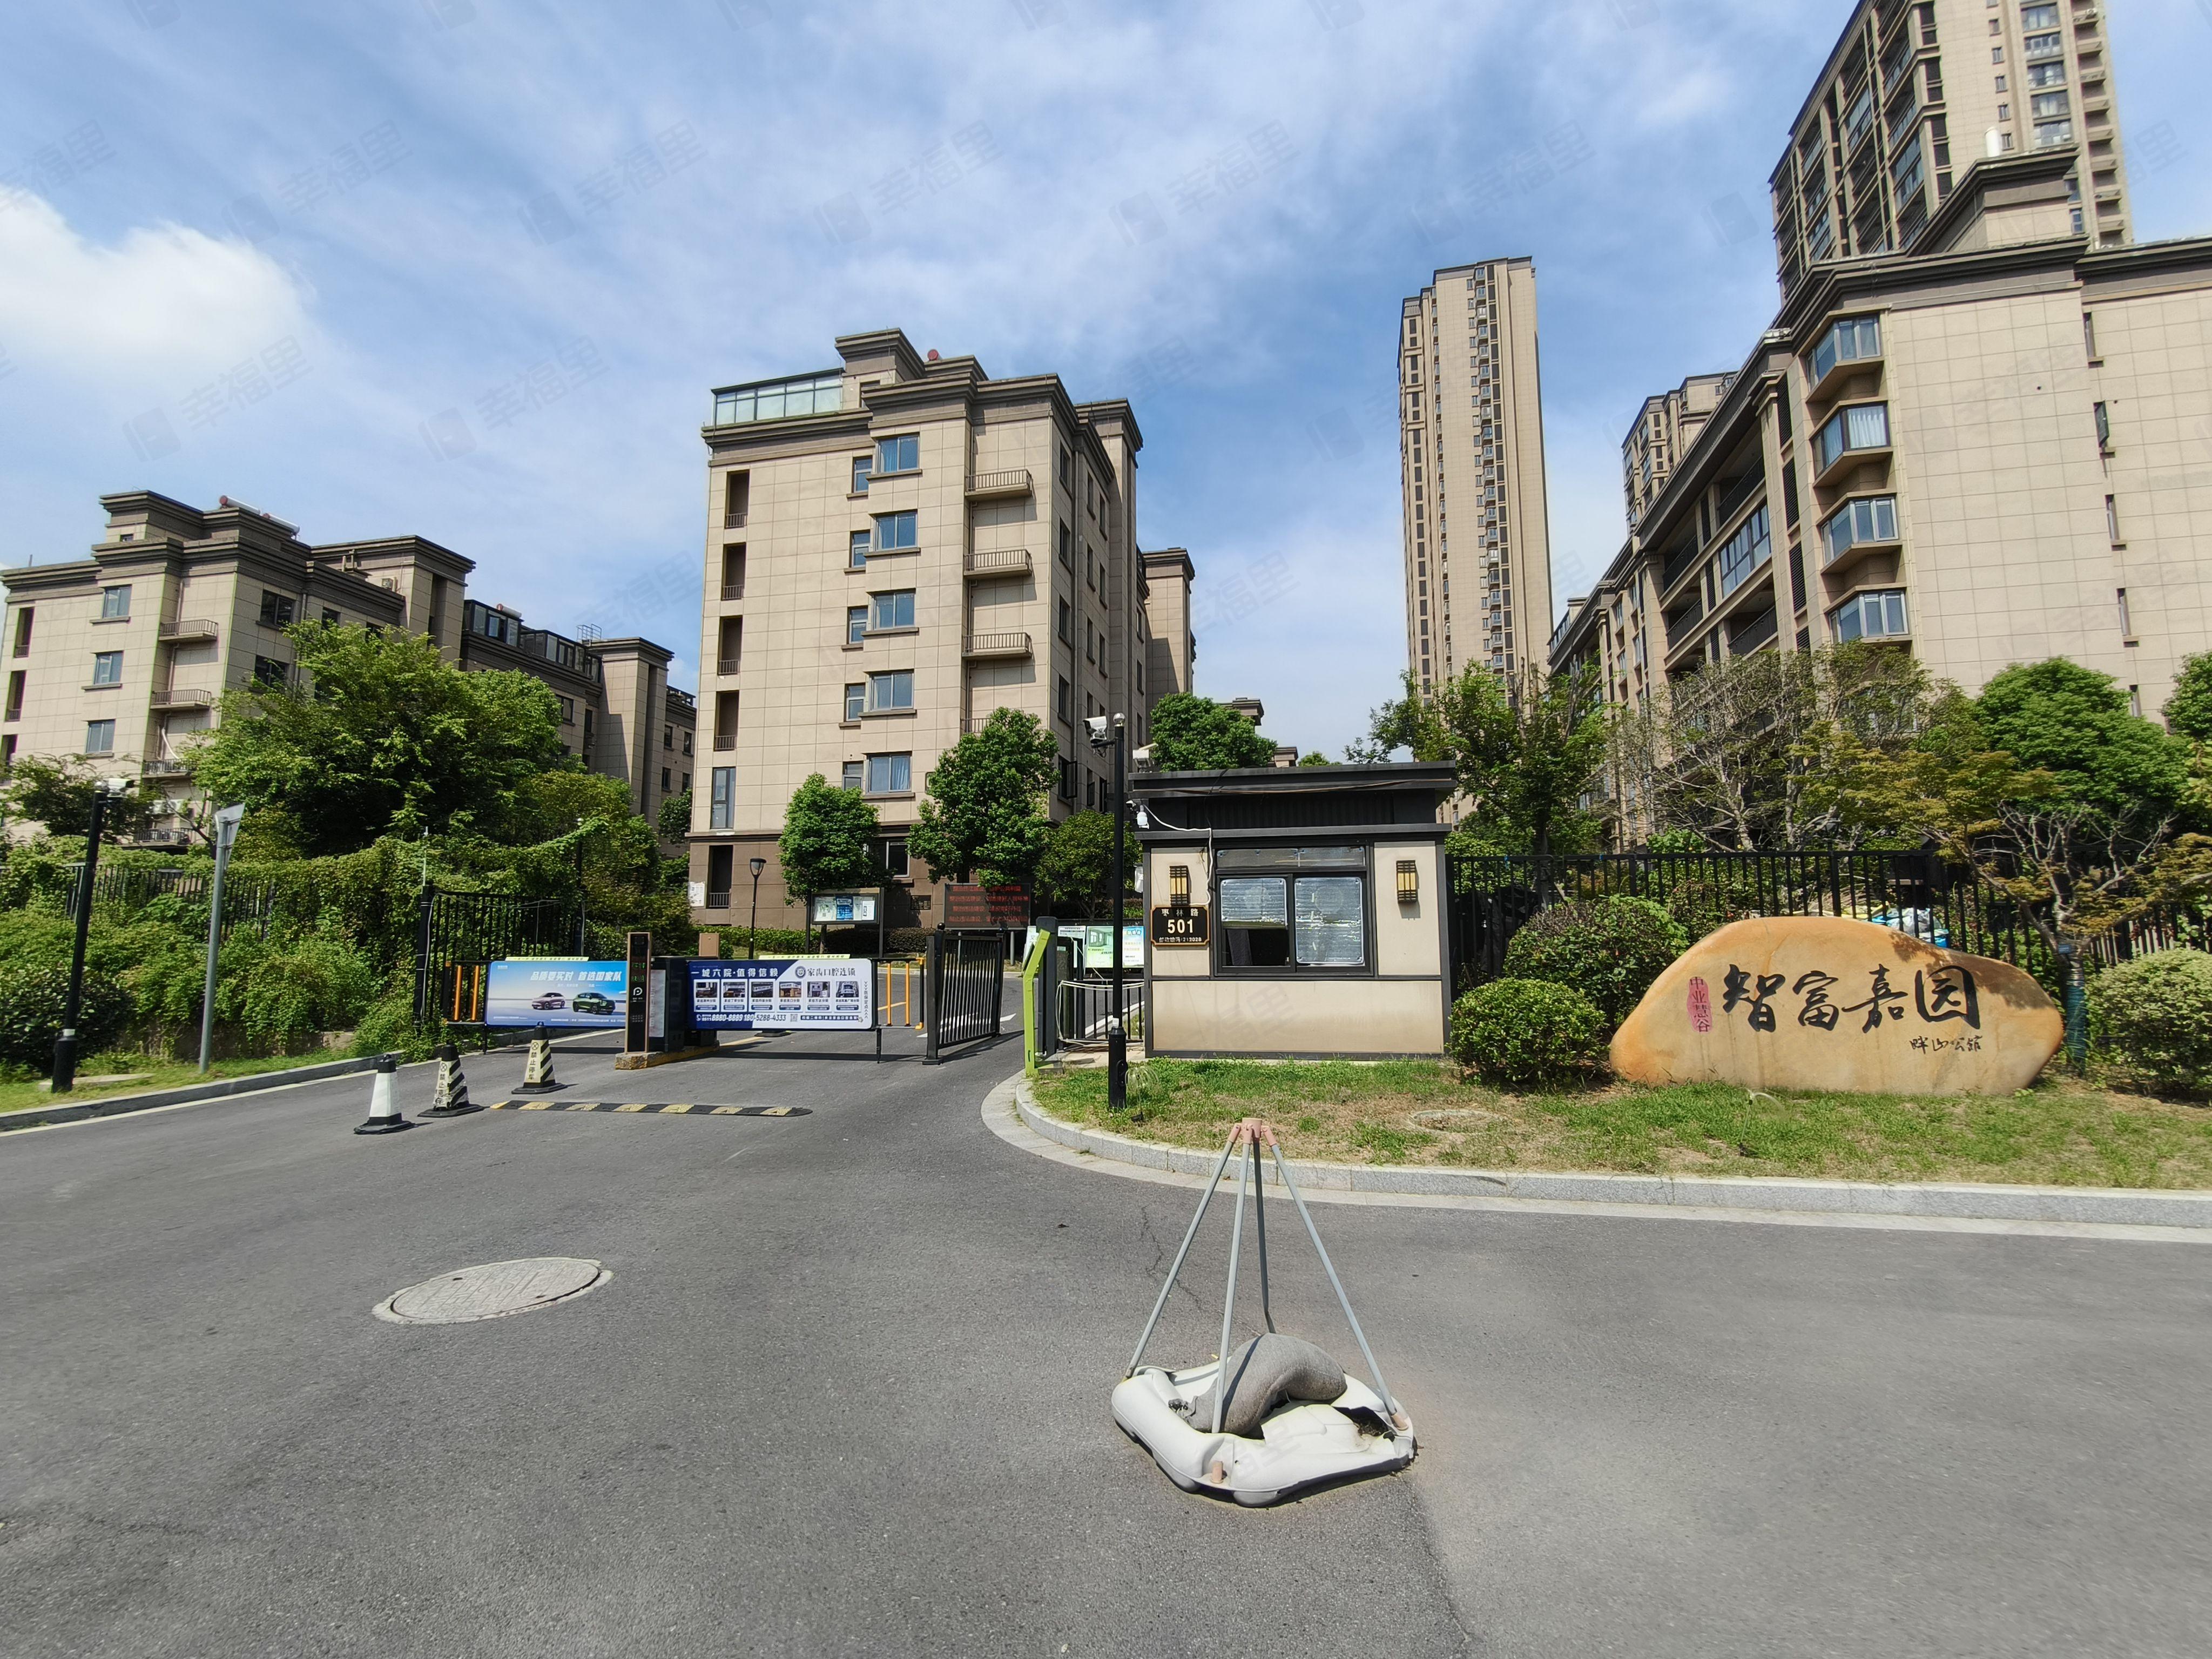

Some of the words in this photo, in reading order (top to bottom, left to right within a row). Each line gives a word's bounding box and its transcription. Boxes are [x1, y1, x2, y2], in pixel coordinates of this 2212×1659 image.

[1167, 919, 1193, 934] 501
[530, 971, 574, 981] 品质要买对
[578, 970, 623, 981] 首选国家队
[1689, 976, 1710, 1033] 中业慧谷
[1722, 963, 1981, 1033] 智富嘉园
[528, 1052, 537, 1080] 禁止停车
